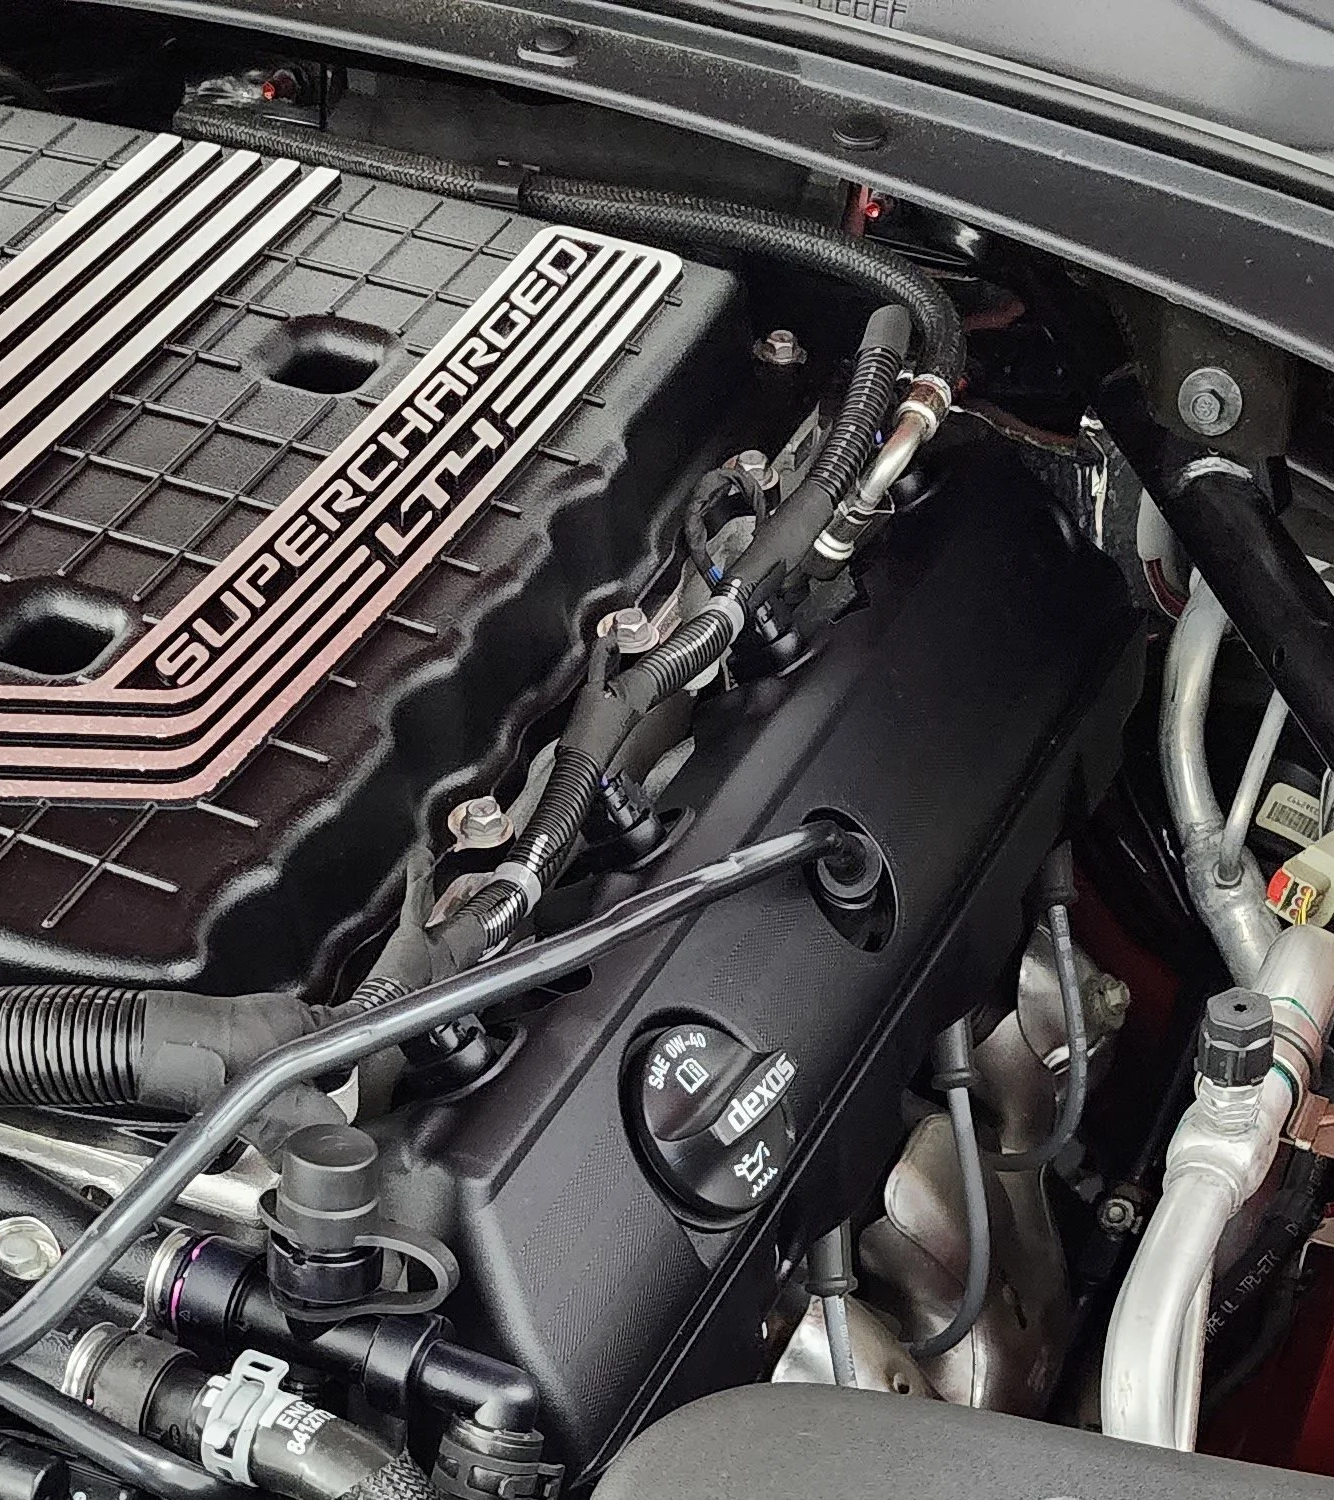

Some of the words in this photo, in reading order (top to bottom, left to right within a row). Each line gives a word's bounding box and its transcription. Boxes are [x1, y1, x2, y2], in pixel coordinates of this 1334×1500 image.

[153, 234, 591, 689] SUPERCHARGED
[382, 421, 504, 562] LT4
[648, 1053, 671, 1090] SAE
[665, 1032, 707, 1059] 0W-40
[727, 1052, 796, 1133] dexos
[278, 1401, 315, 1430] ENG
